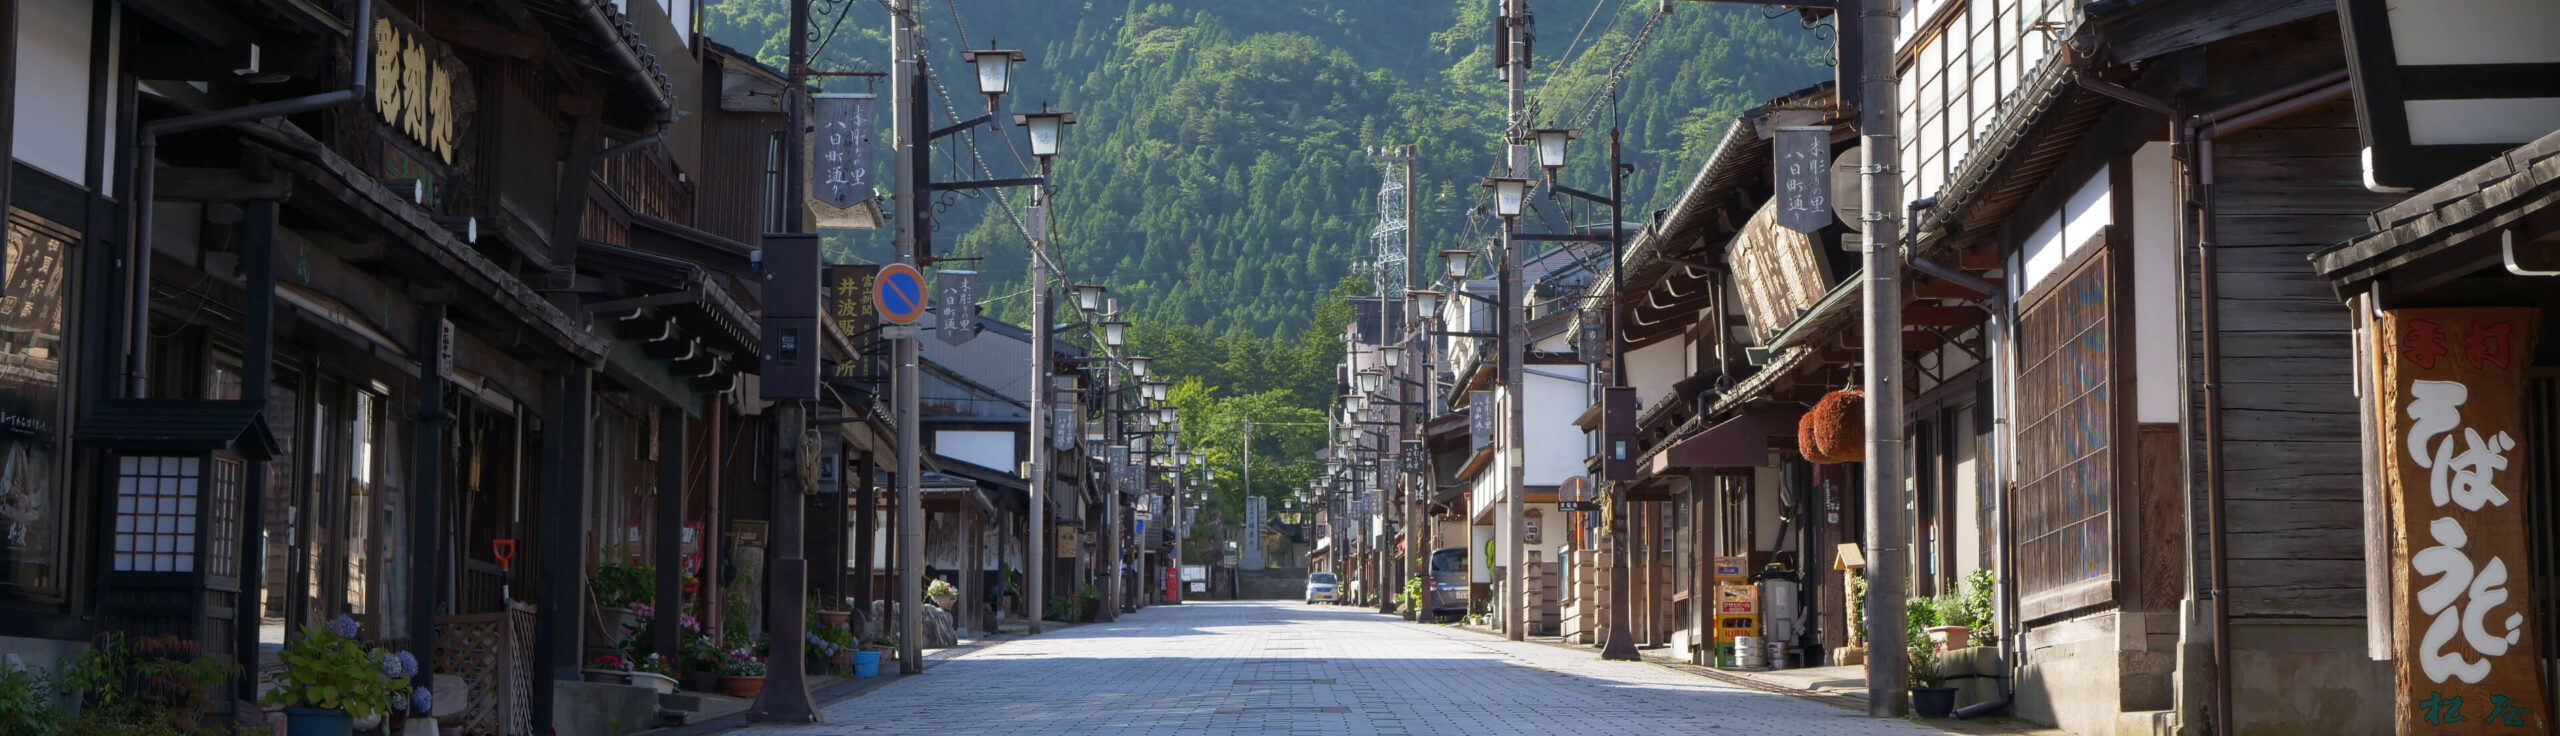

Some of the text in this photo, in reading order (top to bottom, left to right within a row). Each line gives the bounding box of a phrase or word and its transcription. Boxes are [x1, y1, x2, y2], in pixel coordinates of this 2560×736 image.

[375, 16, 453, 165] 彫刻処
[825, 121, 848, 195] 八日町通り
[851, 104, 867, 186] 木彫りの里
[1809, 136, 1825, 213] 木彫りの里
[1785, 151, 1808, 221] 八日町通り
[835, 278, 858, 377] 井波販所
[943, 288, 958, 337] 八日町通り
[960, 277, 972, 332] 木彫りの里
[1725, 629, 1751, 638] KIRIN
